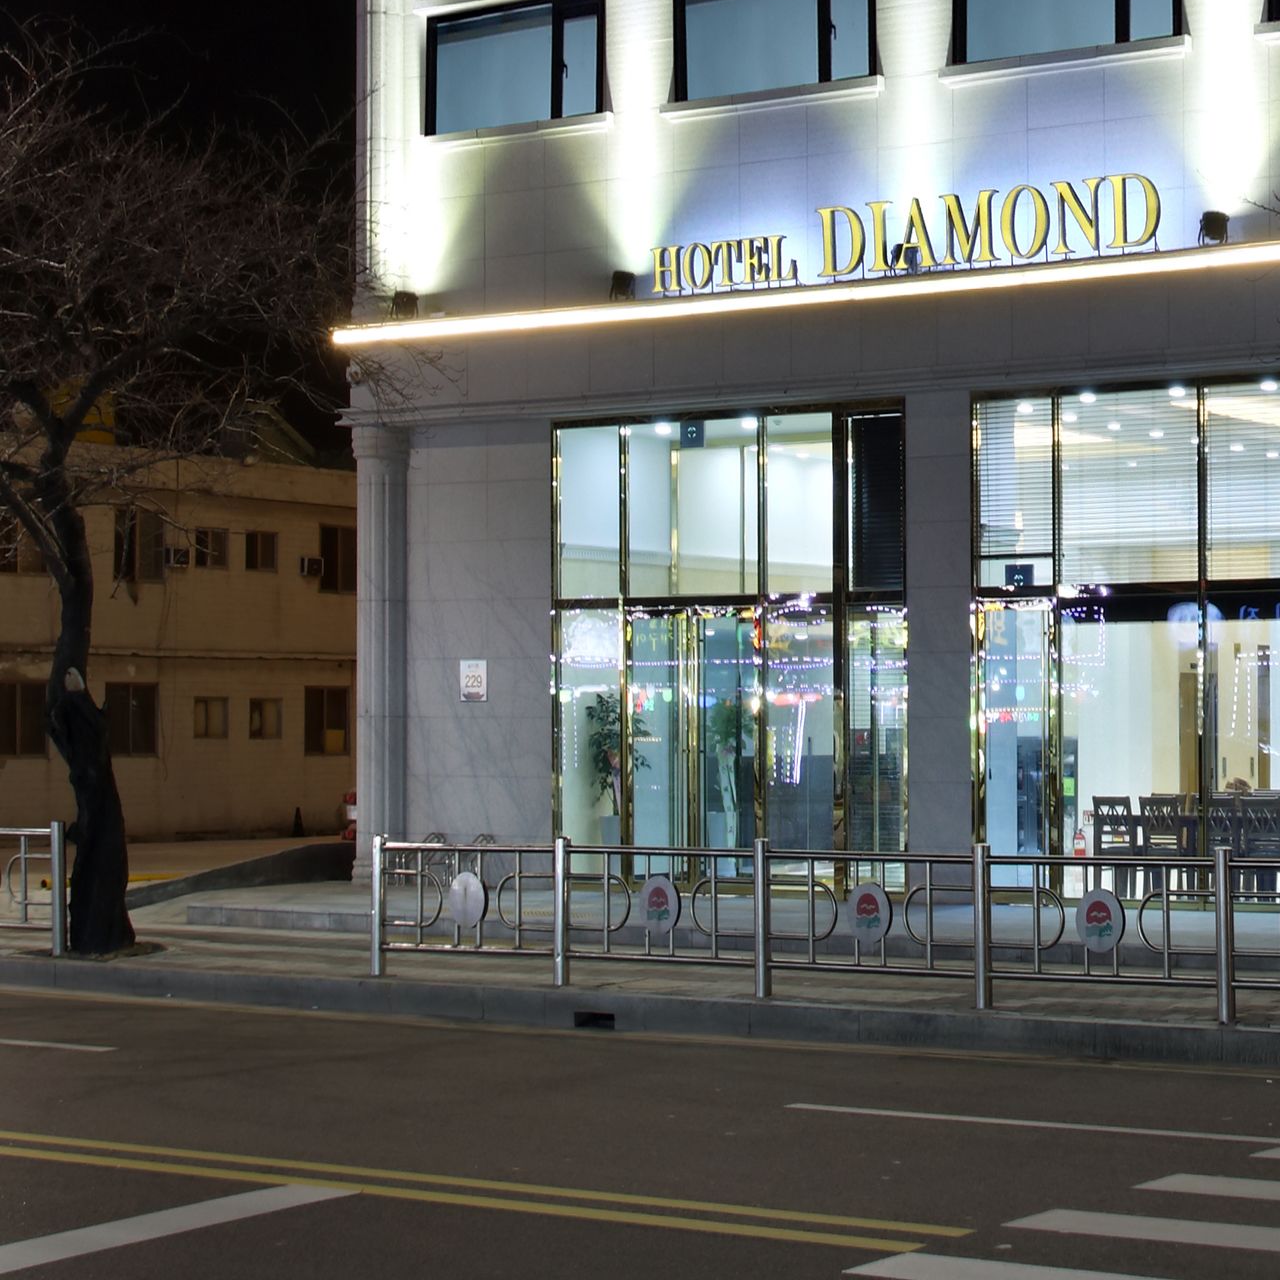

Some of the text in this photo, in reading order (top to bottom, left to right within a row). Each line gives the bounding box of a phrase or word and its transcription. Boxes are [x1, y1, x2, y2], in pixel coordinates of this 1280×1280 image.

[651, 172, 1162, 293] HOTEL DIAMOND
[465, 674, 482, 689] 229
